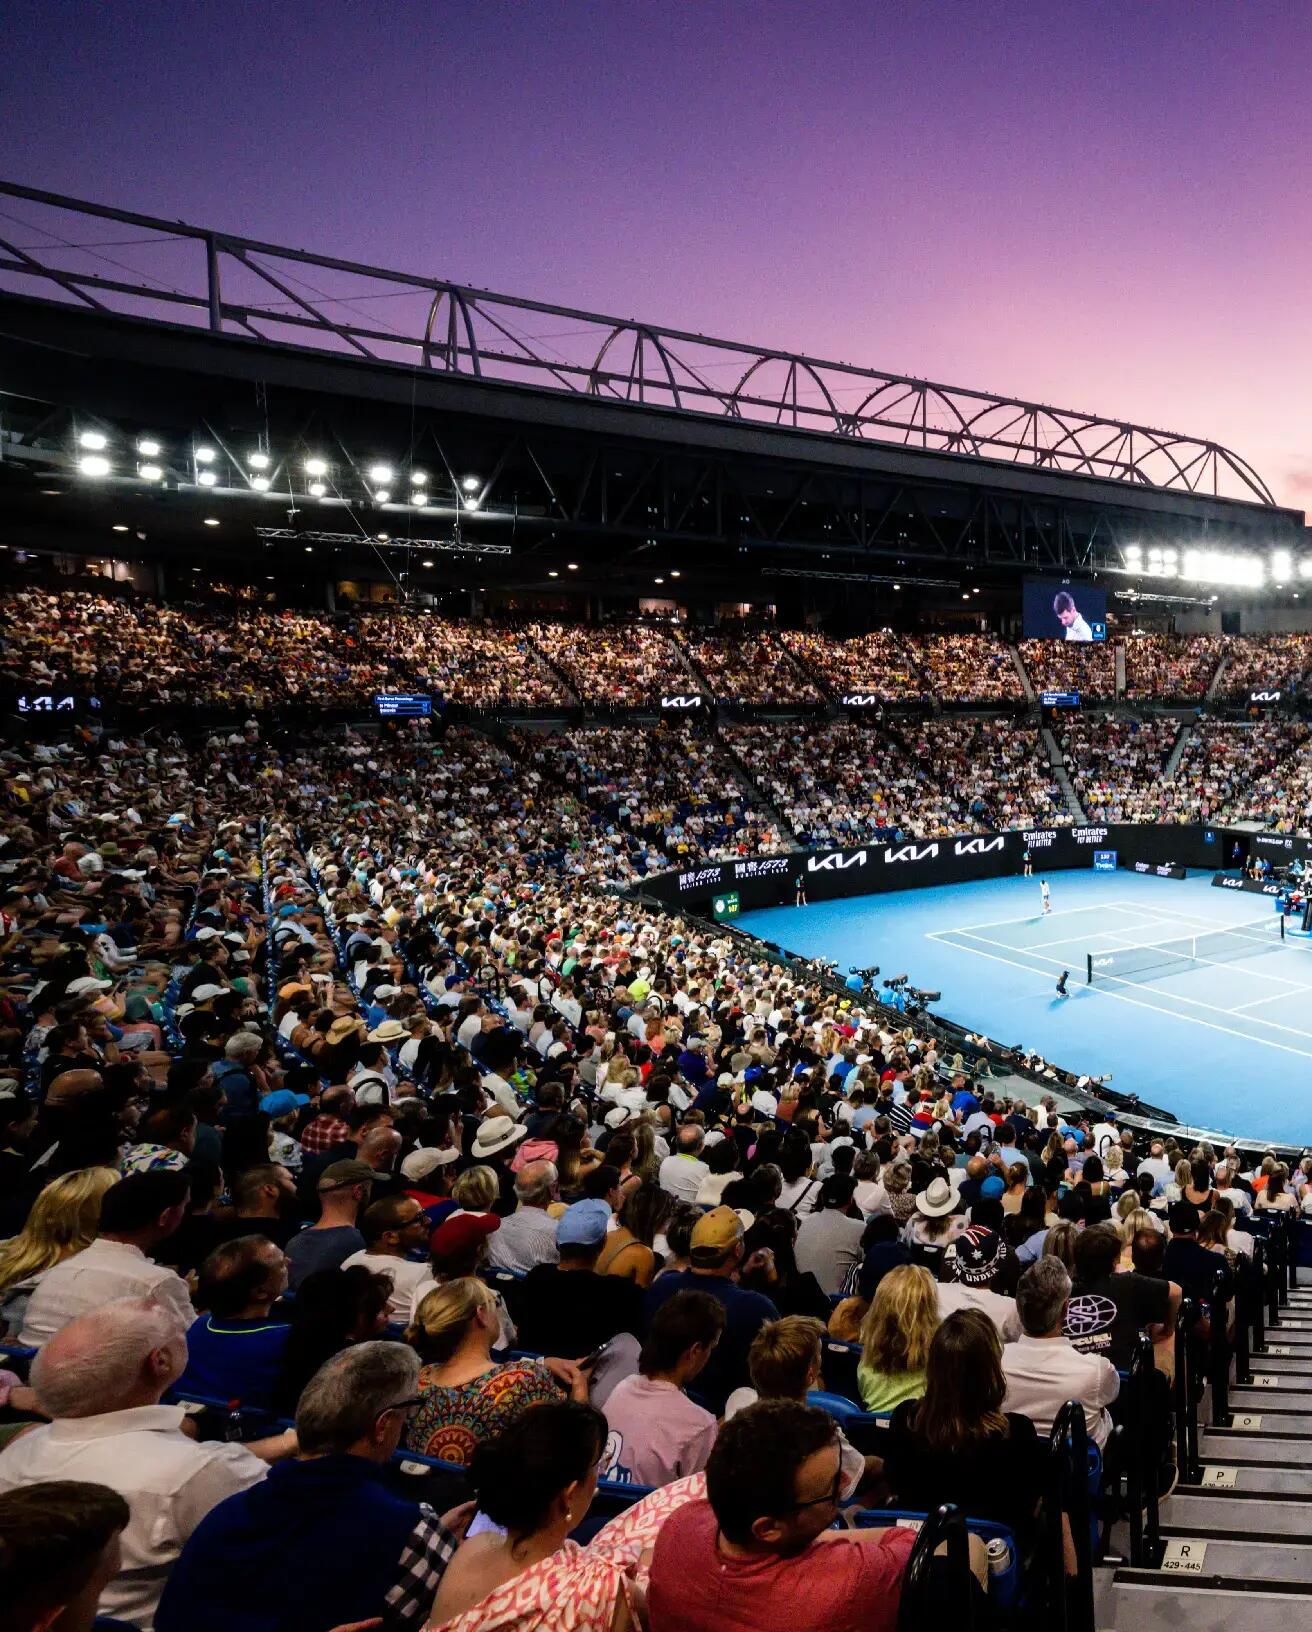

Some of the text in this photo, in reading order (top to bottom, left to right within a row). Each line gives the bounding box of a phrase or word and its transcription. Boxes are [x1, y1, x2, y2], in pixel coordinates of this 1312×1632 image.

[662, 696, 701, 707] KIA
[843, 695, 875, 704] KIA
[1251, 691, 1280, 701] KIA
[1023, 830, 1057, 842] Emirates
[1072, 827, 1108, 838] Emirates
[955, 836, 1004, 856] KIA
[885, 843, 938, 863] KIA
[808, 850, 867, 872] KIA
[1222, 878, 1243, 888] KIA
[965, 1267, 999, 1282] UNDER
[1243, 1418, 1251, 1426] O
[1216, 1471, 1224, 1480] P
[1181, 1545, 1190, 1557] R
[1164, 1561, 1201, 1571] 429-445
